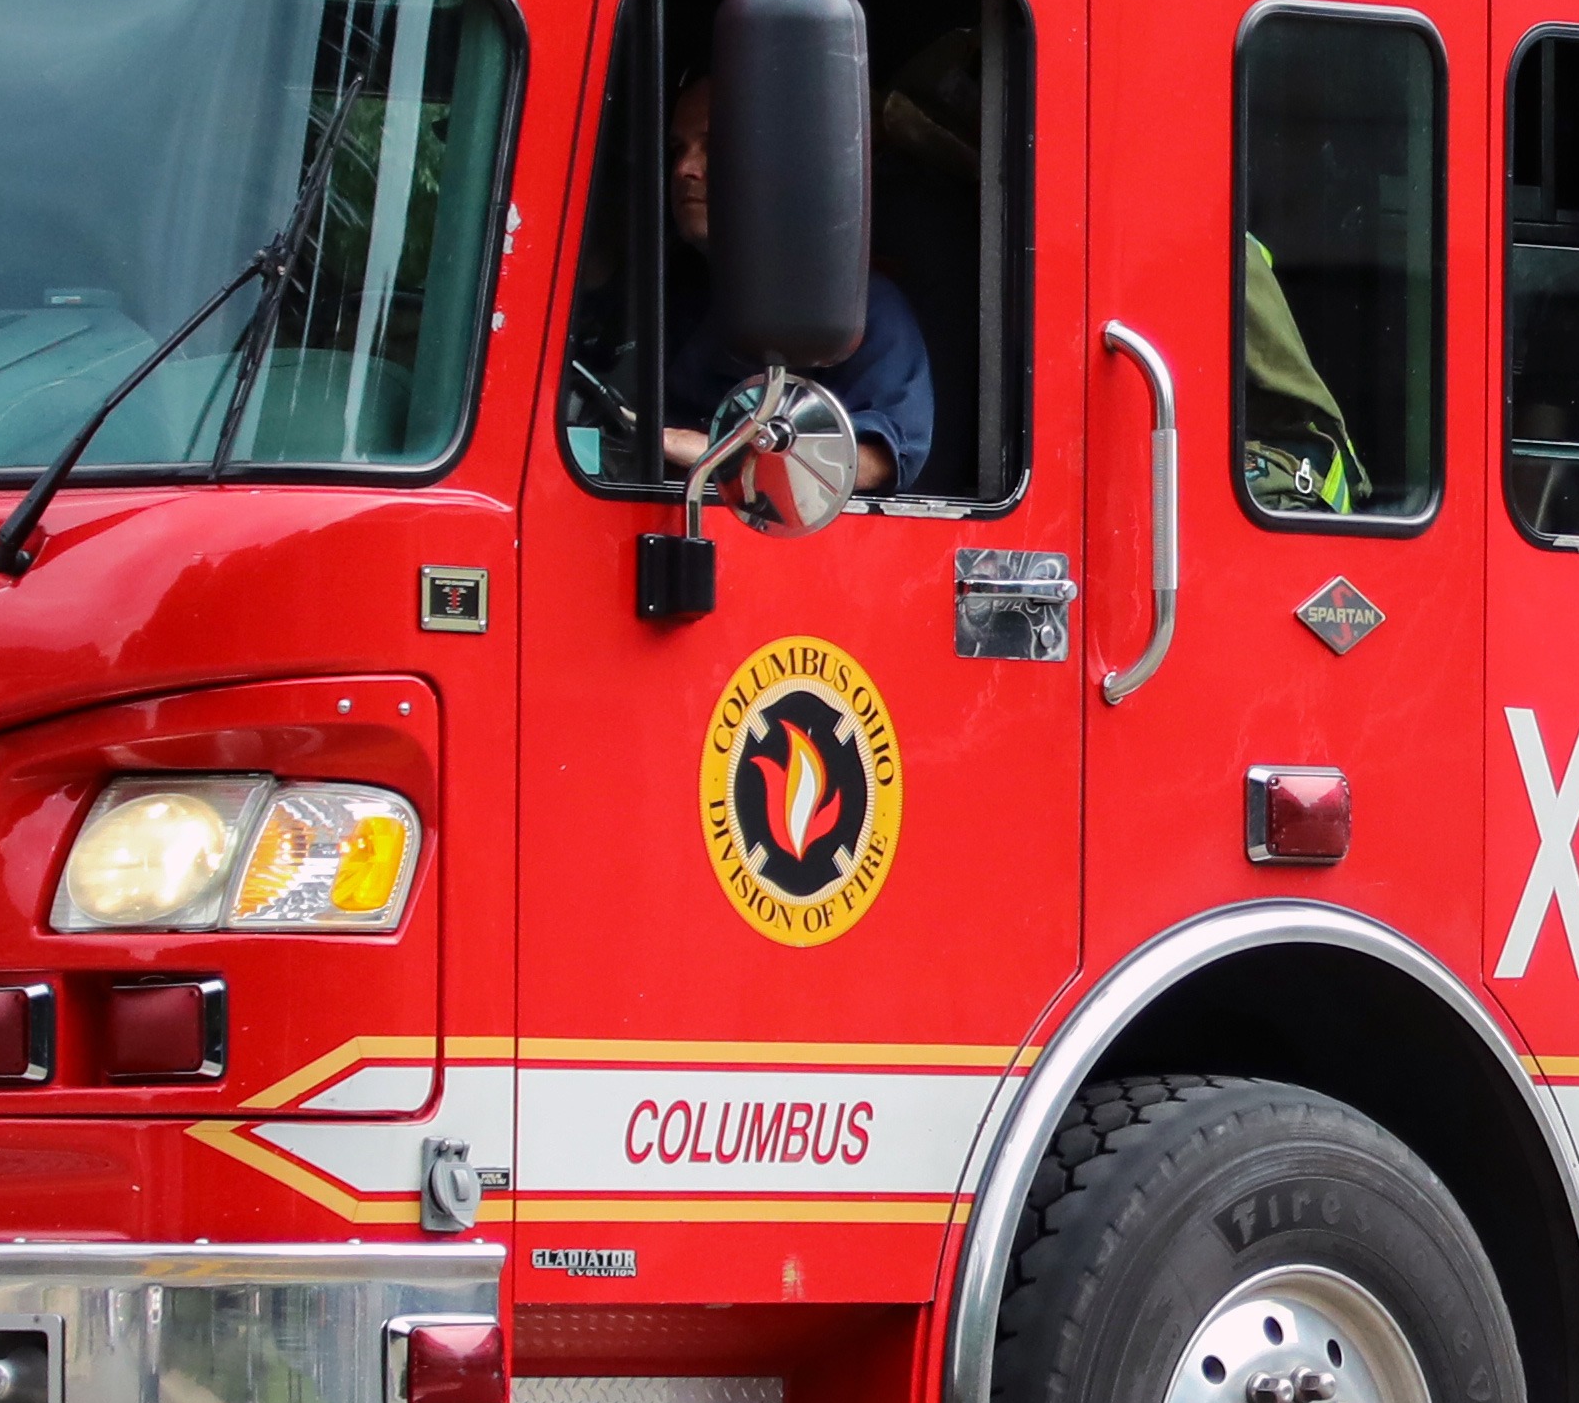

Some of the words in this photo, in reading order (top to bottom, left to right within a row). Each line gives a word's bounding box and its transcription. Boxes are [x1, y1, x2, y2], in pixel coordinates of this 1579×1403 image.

[1308, 606, 1375, 625] SPARTAN
[712, 646, 852, 755] COLUMBUS
[852, 686, 895, 787] OHIO
[708, 799, 795, 932] DIVISION
[803, 899, 836, 934] OF
[842, 830, 889, 914] FIRE
[624, 1099, 874, 1166] COLUMBUS
[531, 1248, 636, 1268] GLADIATOR
[567, 1268, 637, 1277] EVOLUTION
